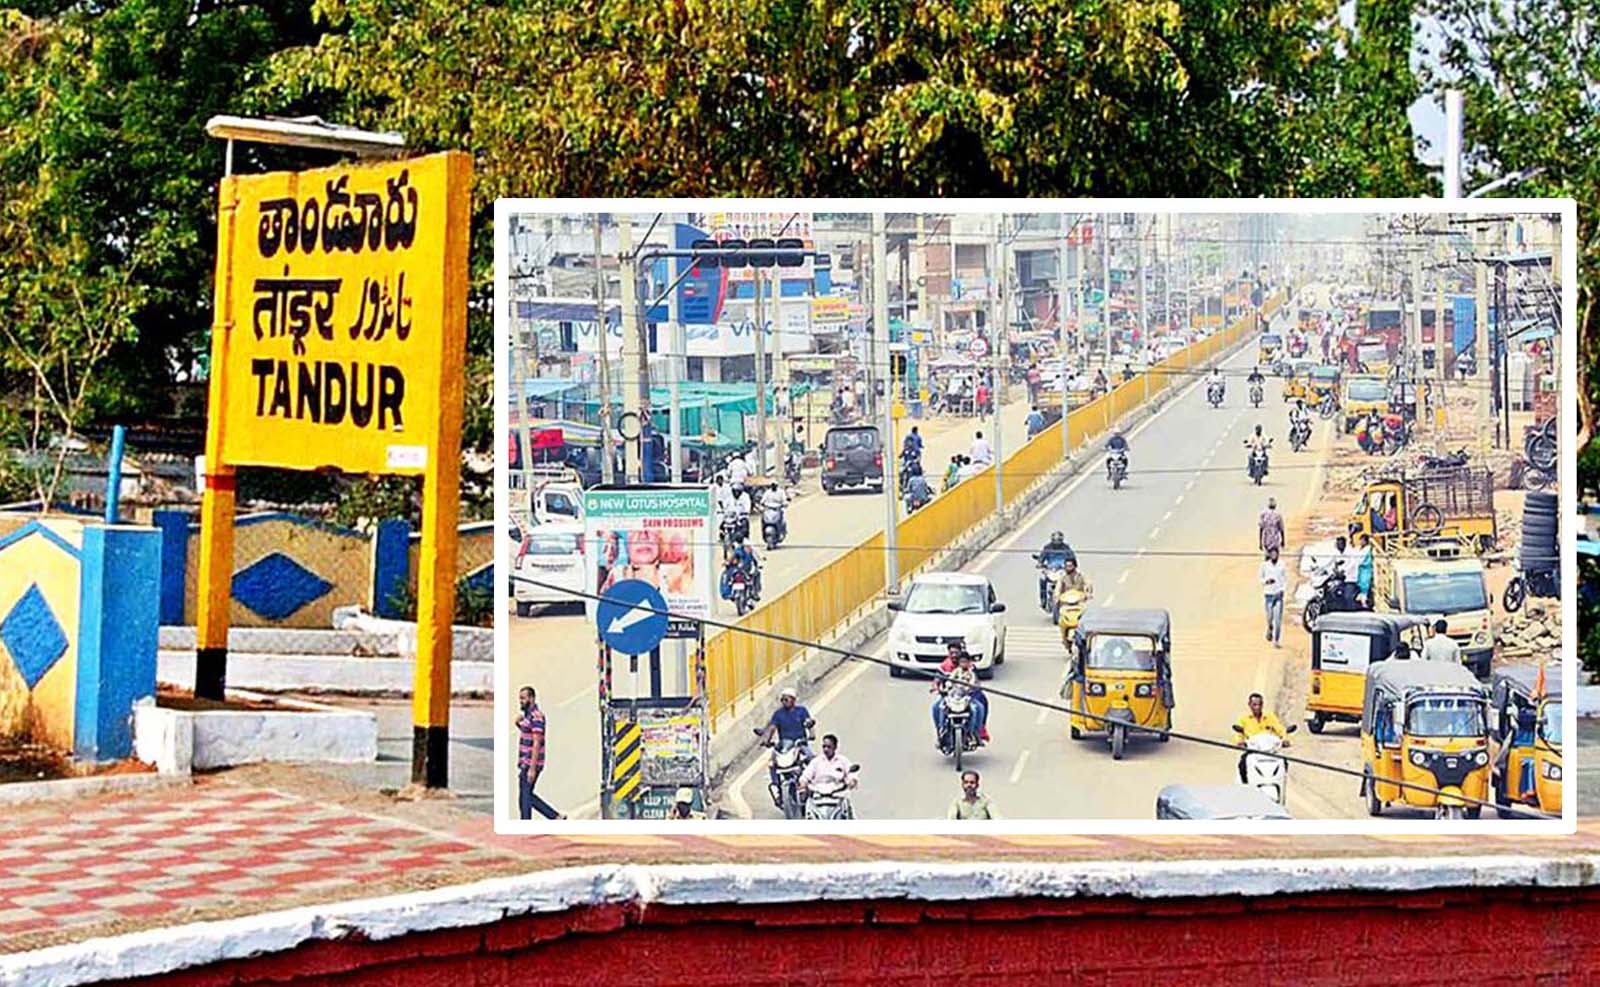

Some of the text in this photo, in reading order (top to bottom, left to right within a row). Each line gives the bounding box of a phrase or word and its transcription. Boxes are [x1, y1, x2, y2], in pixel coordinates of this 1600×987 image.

[251, 358, 406, 430] TANDUR
[600, 497, 708, 509] NEW LOTUS HOSPITAL
